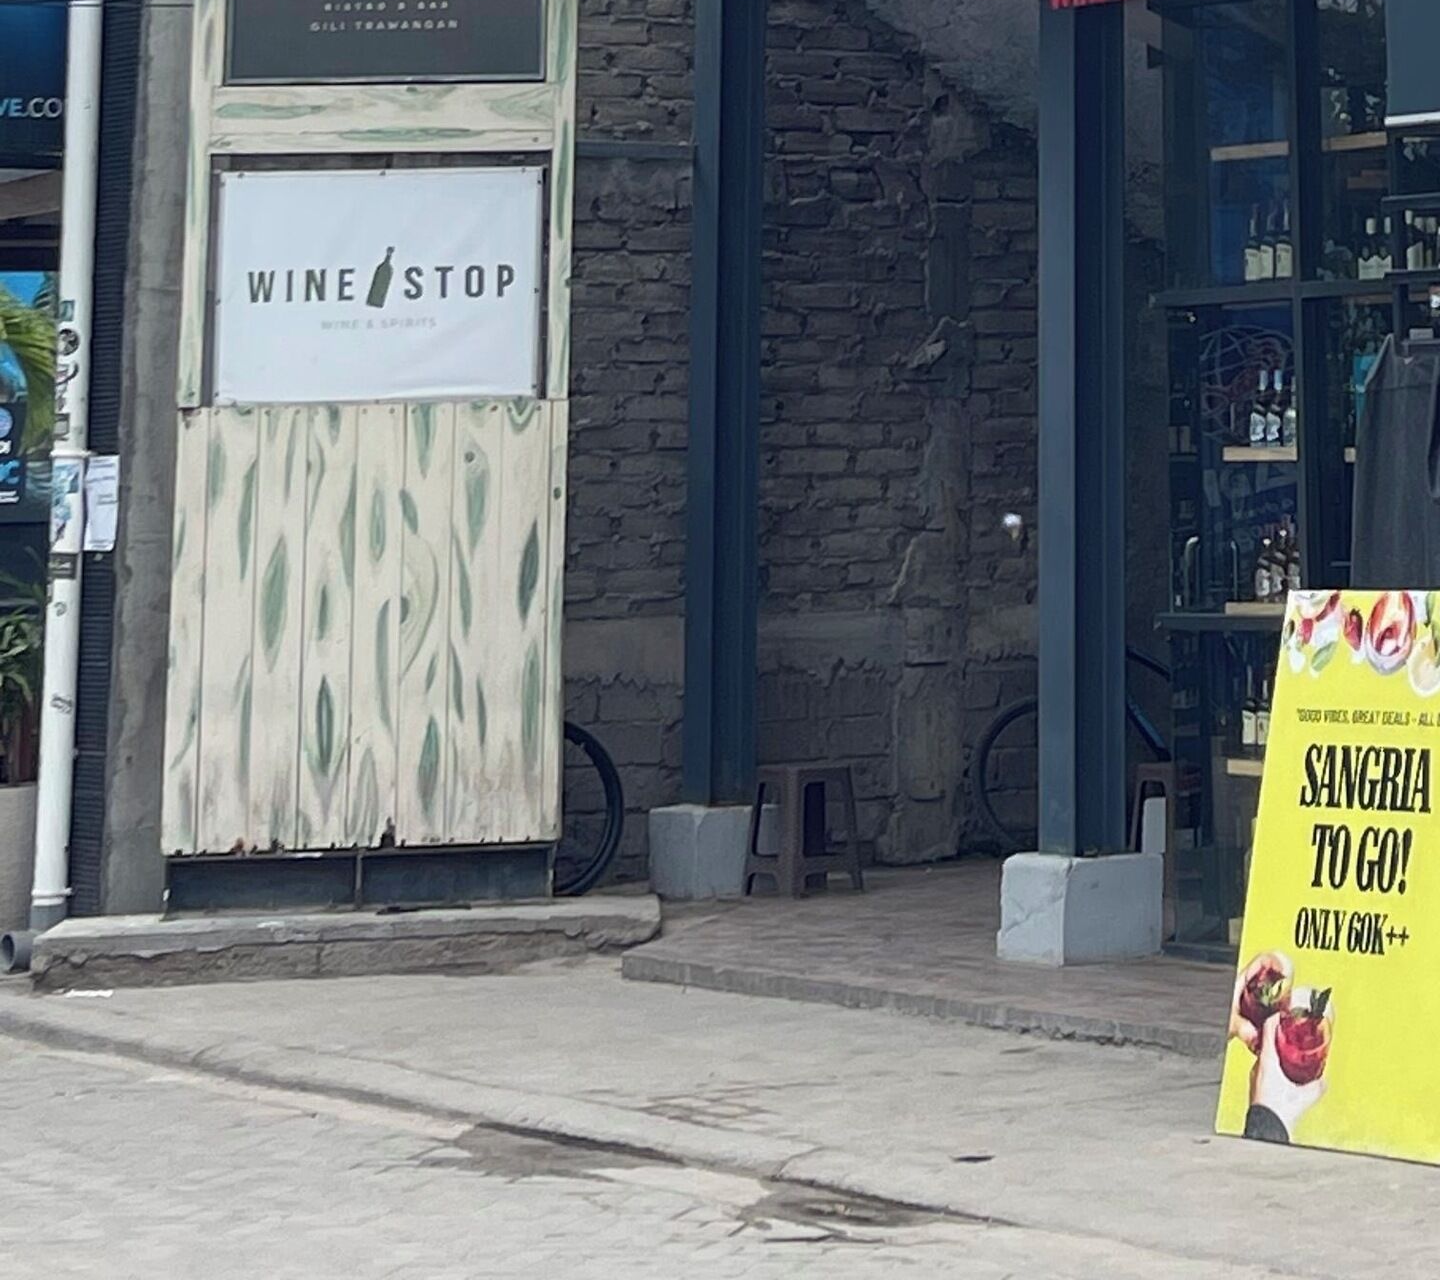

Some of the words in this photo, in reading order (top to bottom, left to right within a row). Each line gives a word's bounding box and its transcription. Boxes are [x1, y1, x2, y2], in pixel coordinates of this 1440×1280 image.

[248, 268, 355, 303] WINE
[403, 264, 515, 301] STOP
[1299, 744, 1432, 814] SANGRIA
[1311, 824, 1348, 891] TO
[1356, 826, 1412, 895] GO!
[1294, 907, 1345, 952] ONLY
[1346, 910, 1410, 956] 60K++
